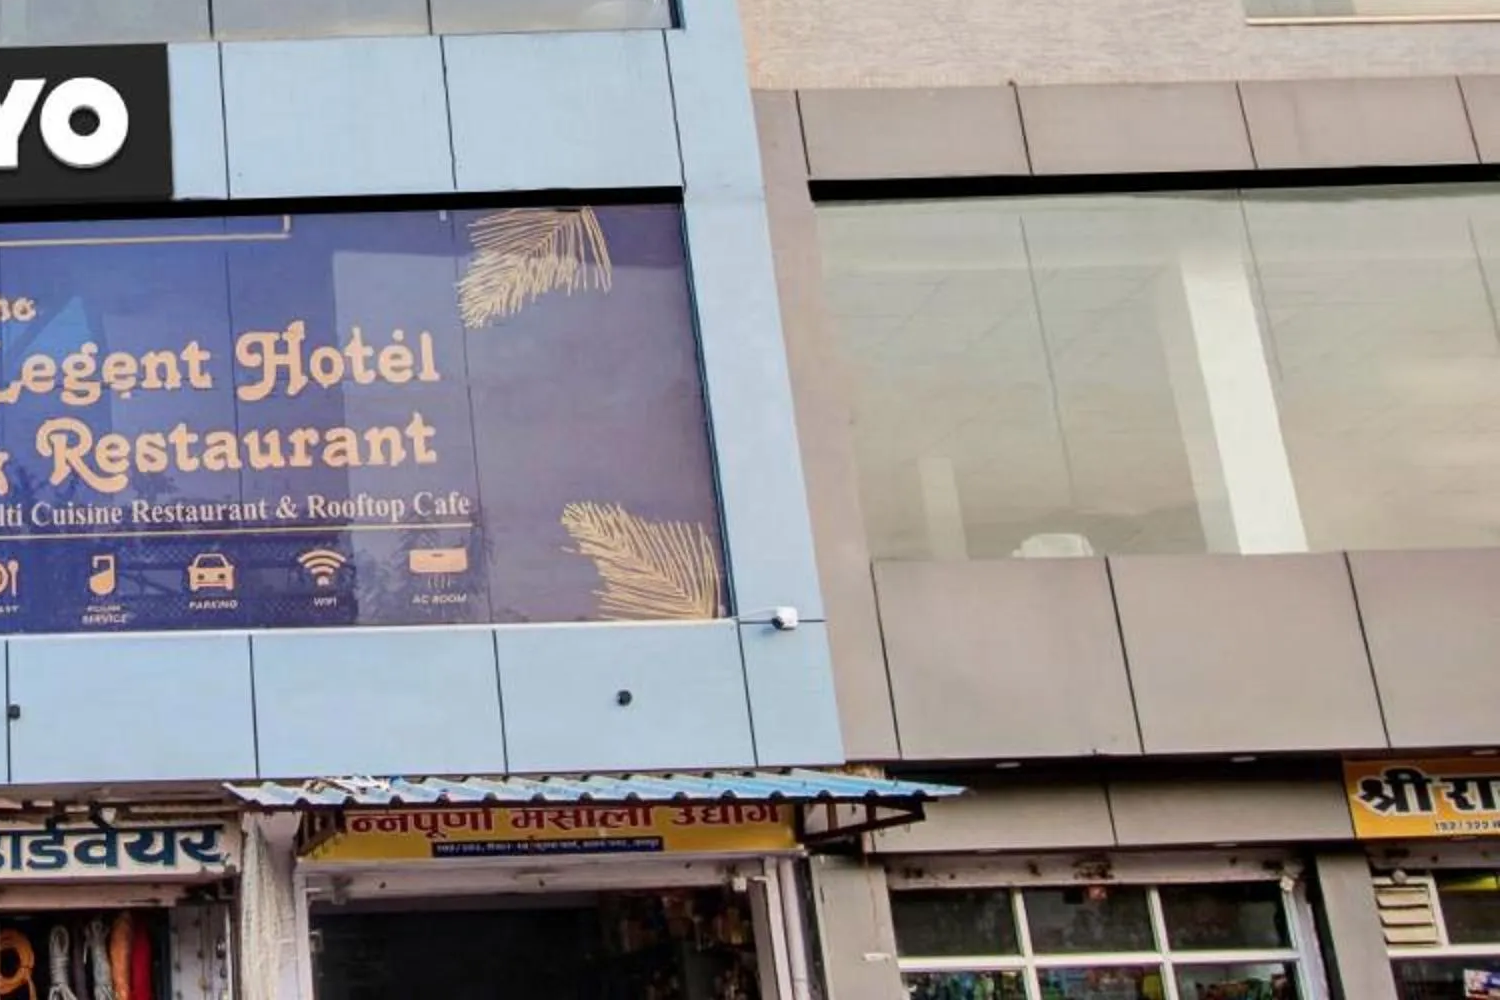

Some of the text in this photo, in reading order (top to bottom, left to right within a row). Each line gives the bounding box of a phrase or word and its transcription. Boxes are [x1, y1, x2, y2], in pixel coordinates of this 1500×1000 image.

[236, 320, 440, 401] Hotel
[35, 410, 438, 494] Restaurant
[31, 502, 122, 526] Cuisine
[131, 498, 268, 524] Restaurant
[275, 496, 298, 519] &
[308, 492, 405, 523] Rooftop
[414, 492, 471, 517] Cafe
[189, 600, 238, 610] PARKING
[1360, 768, 1433, 813] श्री
[511, 807, 652, 829] मसाला
